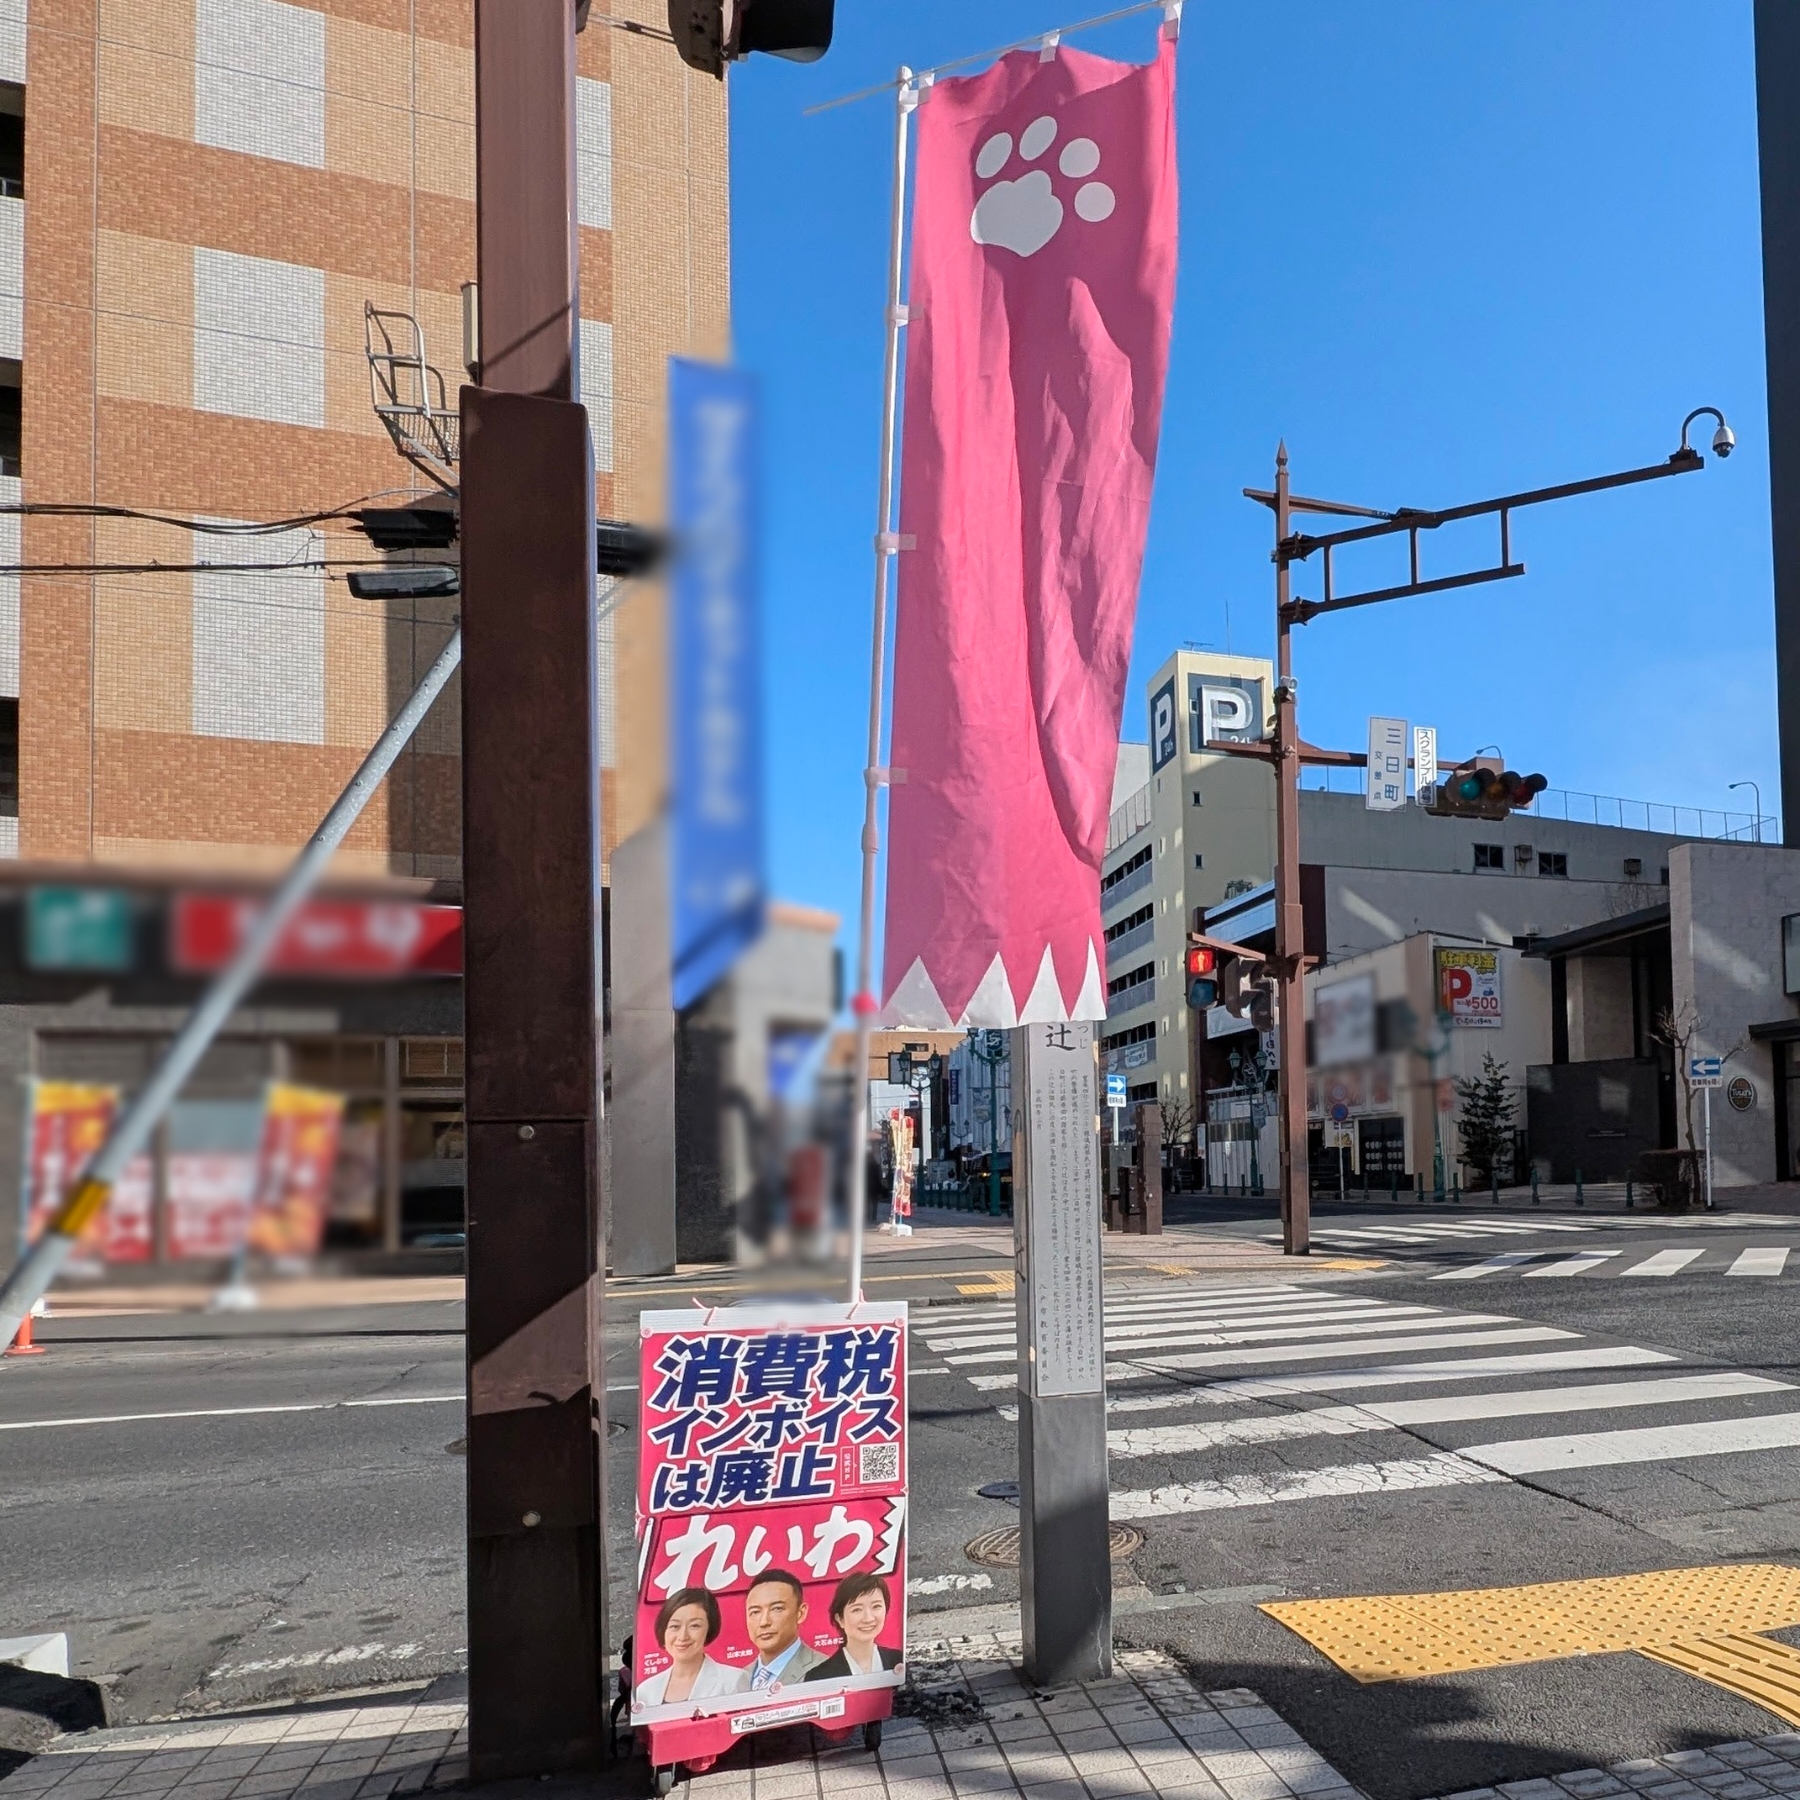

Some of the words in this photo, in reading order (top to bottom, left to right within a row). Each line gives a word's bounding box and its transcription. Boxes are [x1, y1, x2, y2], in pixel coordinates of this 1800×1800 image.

[1154, 693, 1173, 764] P
[1202, 684, 1254, 747] P
[1372, 751, 1384, 801] 交差点
[1384, 727, 1402, 802] 三日町
[1418, 731, 1433, 804] スクランブル信号
[1045, 1023, 1076, 1051] 辻
[1077, 1025, 1089, 1050] つじ
[650, 1328, 898, 1409] 消費税
[651, 1397, 901, 1456] インボイス
[652, 1444, 833, 1511] は廃止
[654, 1505, 875, 1600] れいわ
